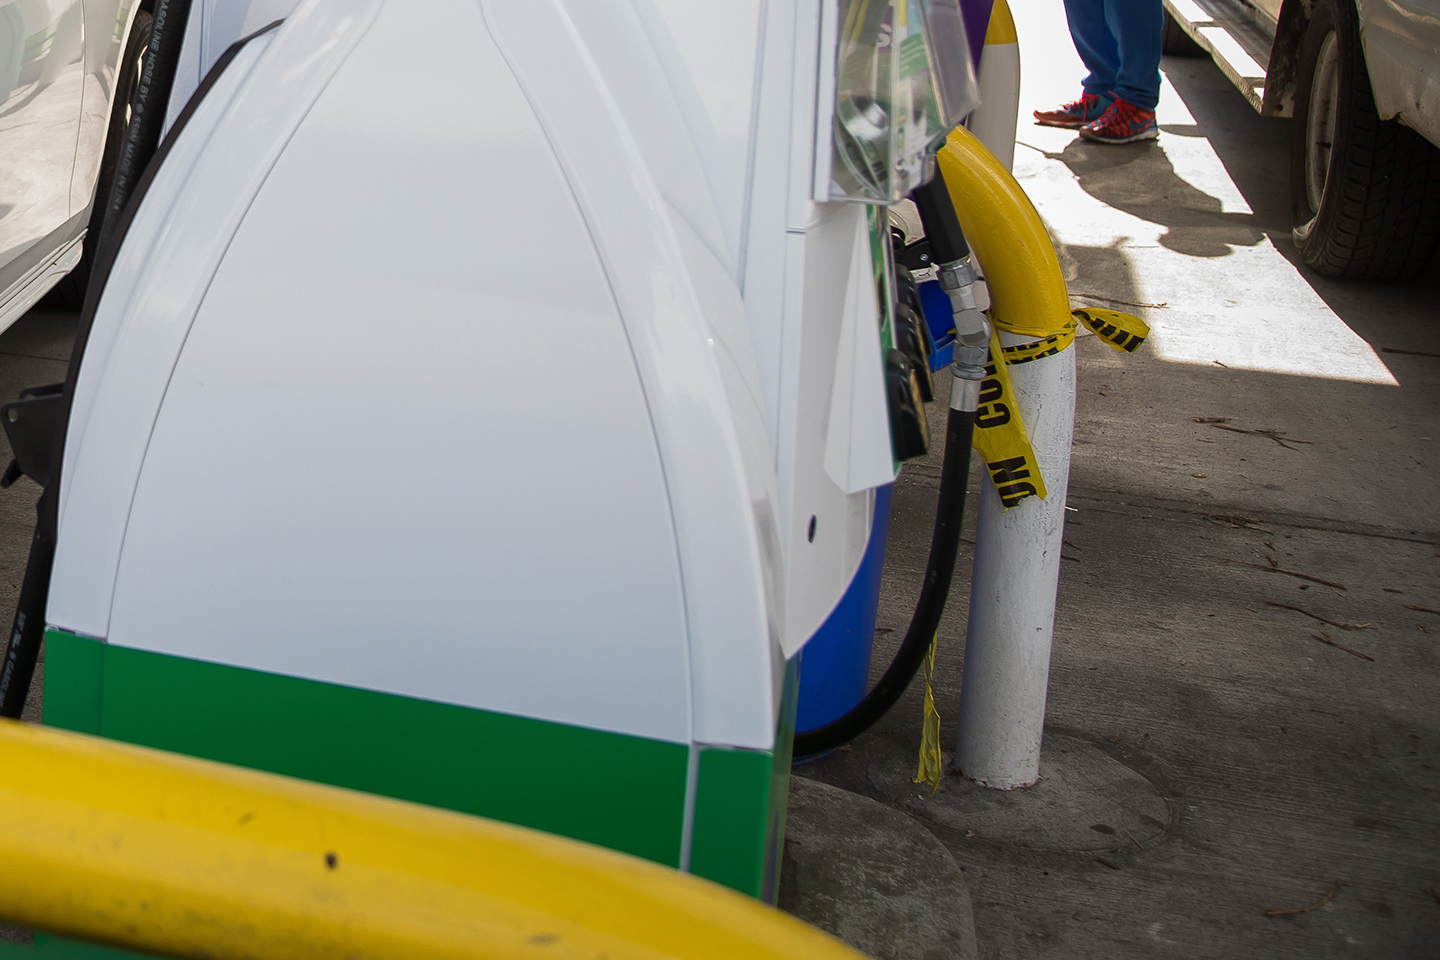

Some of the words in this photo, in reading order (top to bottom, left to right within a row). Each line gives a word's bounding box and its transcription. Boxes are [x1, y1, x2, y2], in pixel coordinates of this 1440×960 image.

[143, 52, 157, 86] HOSE
[138, 85, 150, 102] BY
[119, 143, 135, 177] MADE
[117, 176, 128, 189] IN
